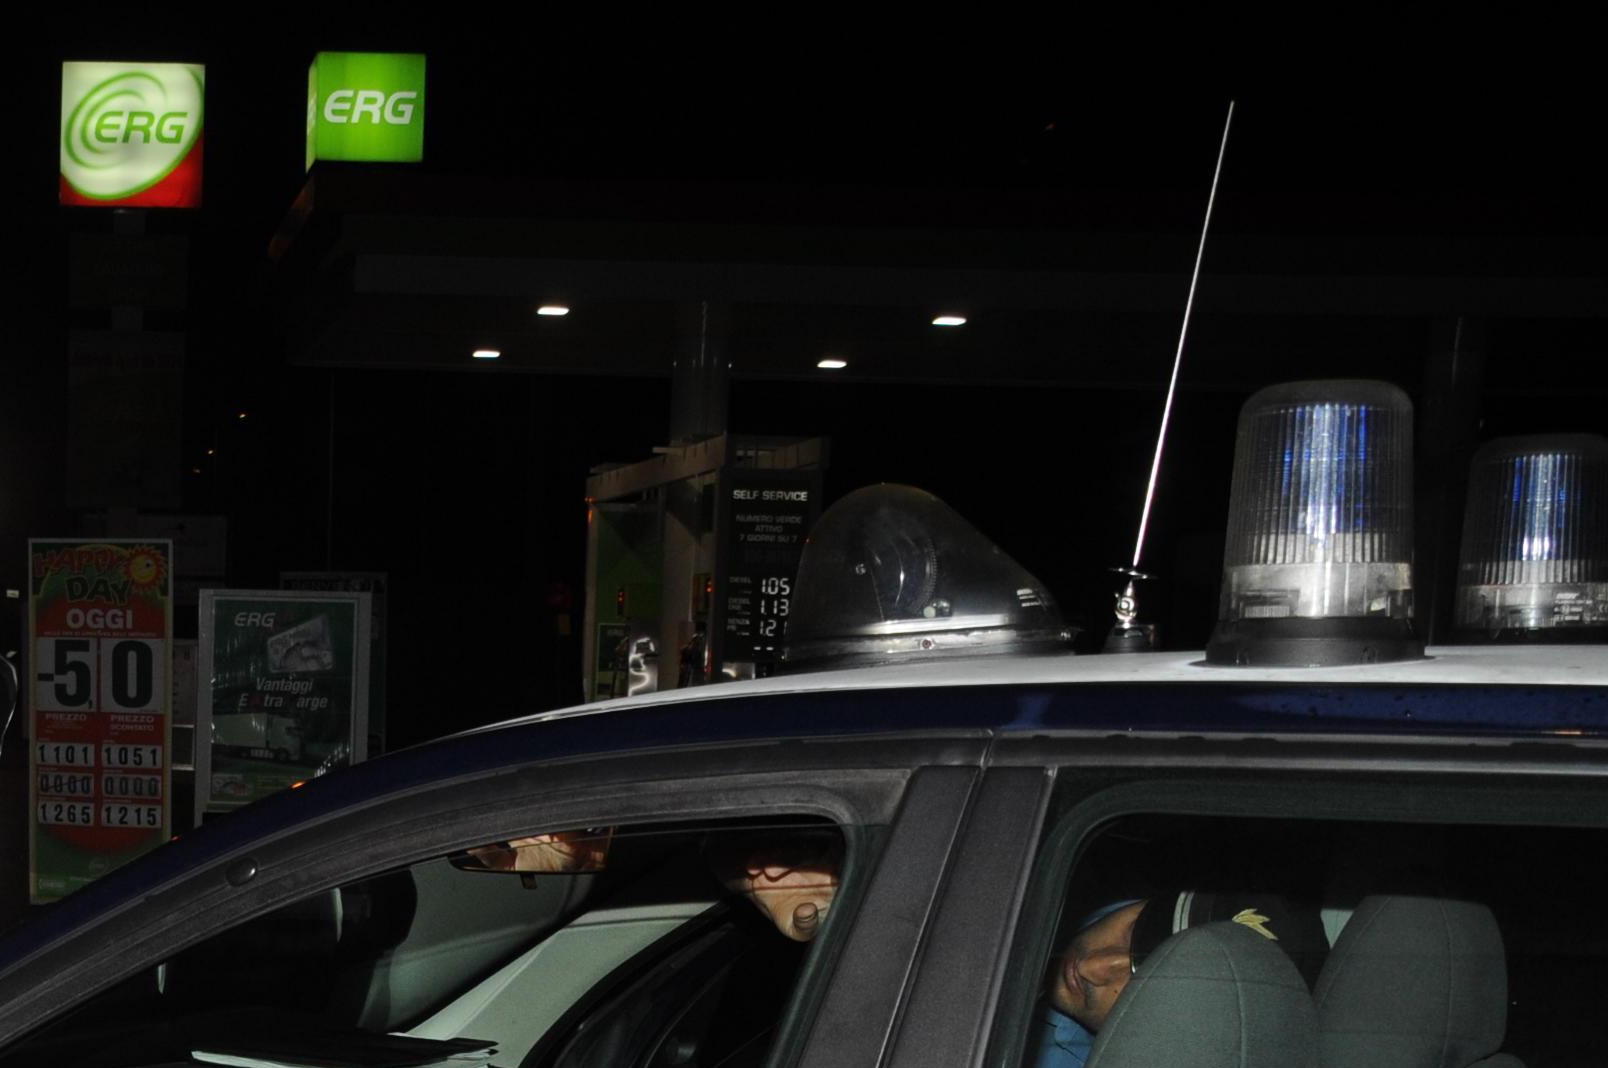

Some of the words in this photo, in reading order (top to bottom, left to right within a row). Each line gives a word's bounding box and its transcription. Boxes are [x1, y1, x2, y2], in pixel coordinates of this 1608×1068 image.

[323, 89, 418, 125] ERG
[94, 111, 188, 144] ERG
[733, 489, 759, 500] SELF
[762, 490, 808, 501] SERVICE
[33, 548, 129, 577] HAPPY
[65, 573, 130, 606] DAY
[65, 607, 133, 629] OGGI
[233, 611, 277, 628] ERG
[255, 676, 315, 695] Vantaggi
[45, 712, 88, 721] PREZZO
[110, 714, 155, 723] PREZZO
